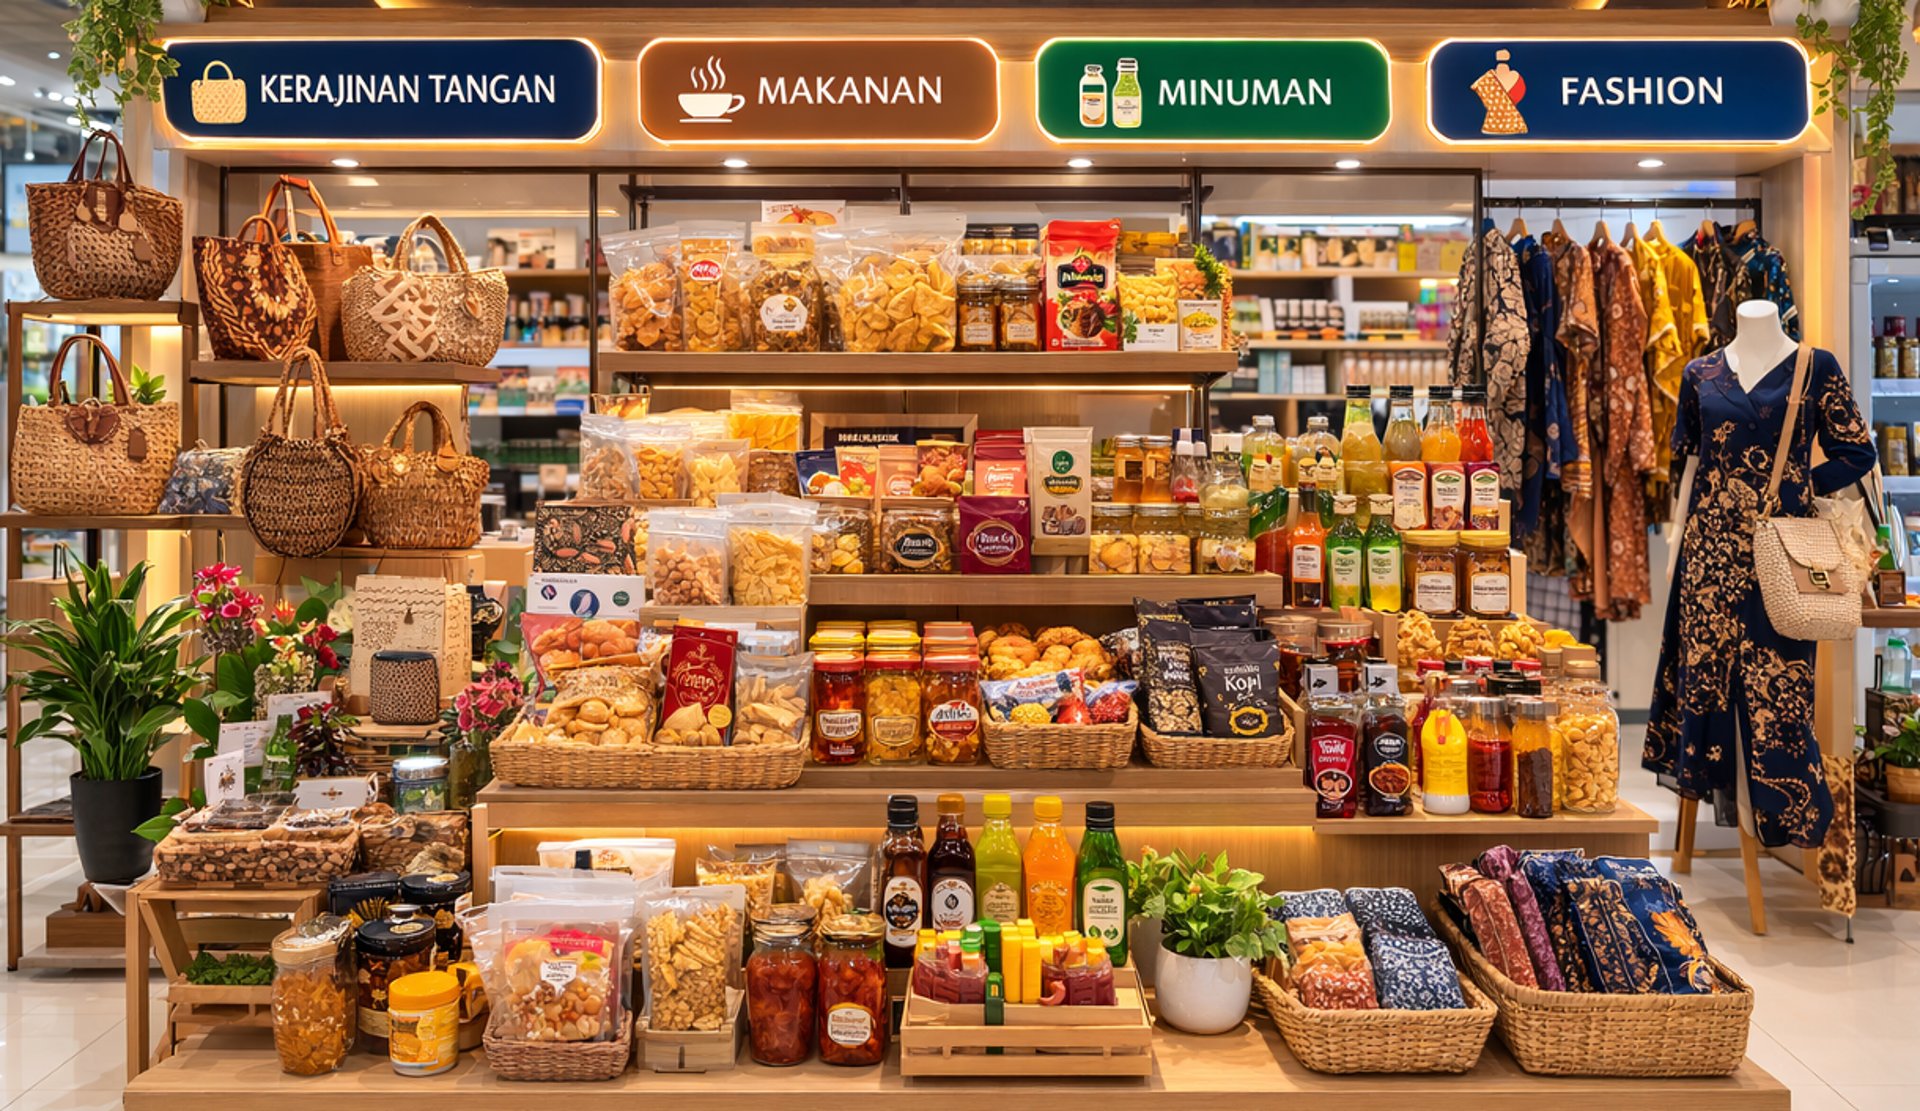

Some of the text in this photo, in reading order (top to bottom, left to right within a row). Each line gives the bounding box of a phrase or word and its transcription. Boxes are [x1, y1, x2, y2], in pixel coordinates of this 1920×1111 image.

[260, 75, 556, 106] KERAJINAN TANGAN
[758, 77, 943, 104] MAKANAN
[1158, 77, 1332, 105] MINUMAN
[1561, 76, 1724, 106] FASHION
